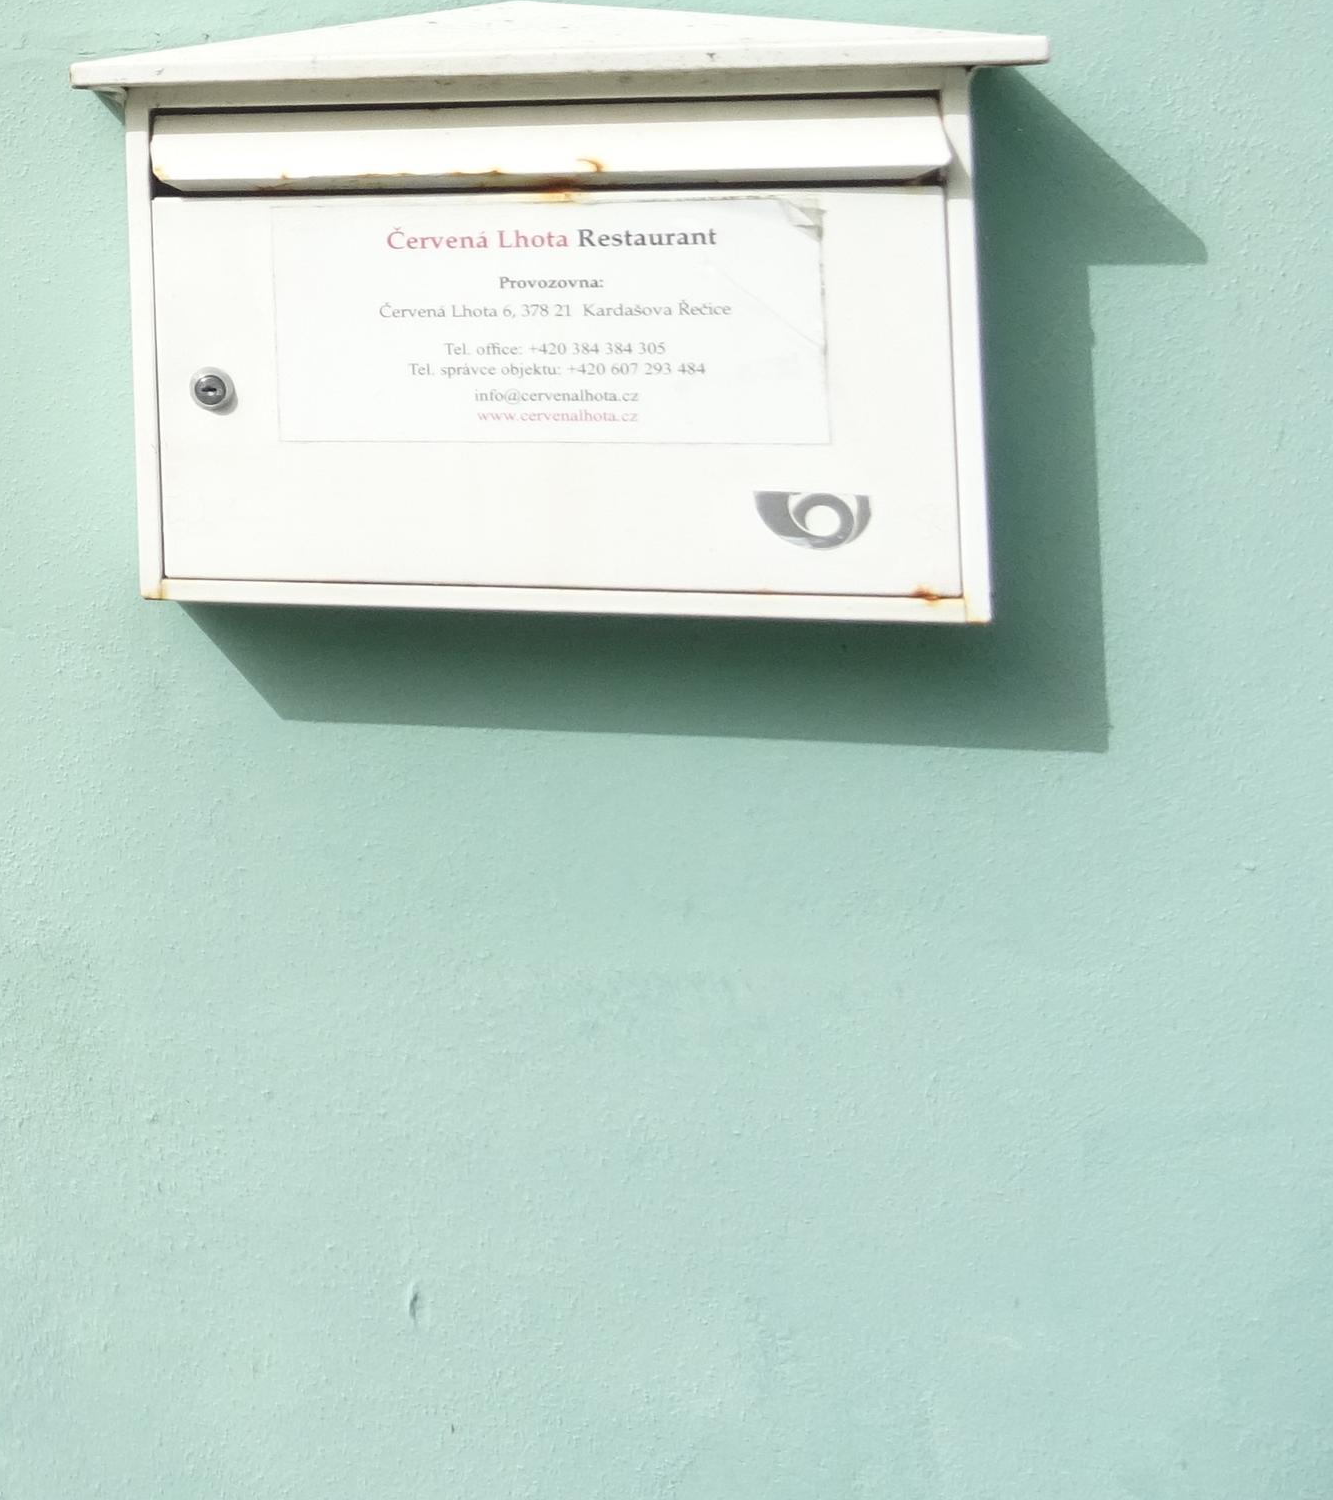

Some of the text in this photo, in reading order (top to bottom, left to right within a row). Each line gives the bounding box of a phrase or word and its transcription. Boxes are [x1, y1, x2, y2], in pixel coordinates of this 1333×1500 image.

[386, 226, 717, 250] Červená Lhota Restaurant
[499, 276, 604, 289] Provozovna:
[379, 299, 732, 318] Červená Lhota 6, 378 21 Kardašova Řečice
[444, 341, 666, 356] Tel. office: +420 384 384 305
[408, 362, 706, 379] Tel. správce objektu: +420 607 293 484
[475, 388, 639, 405] info@cervenalhota.cz
[477, 409, 638, 422] www.cervenalhota.cz
